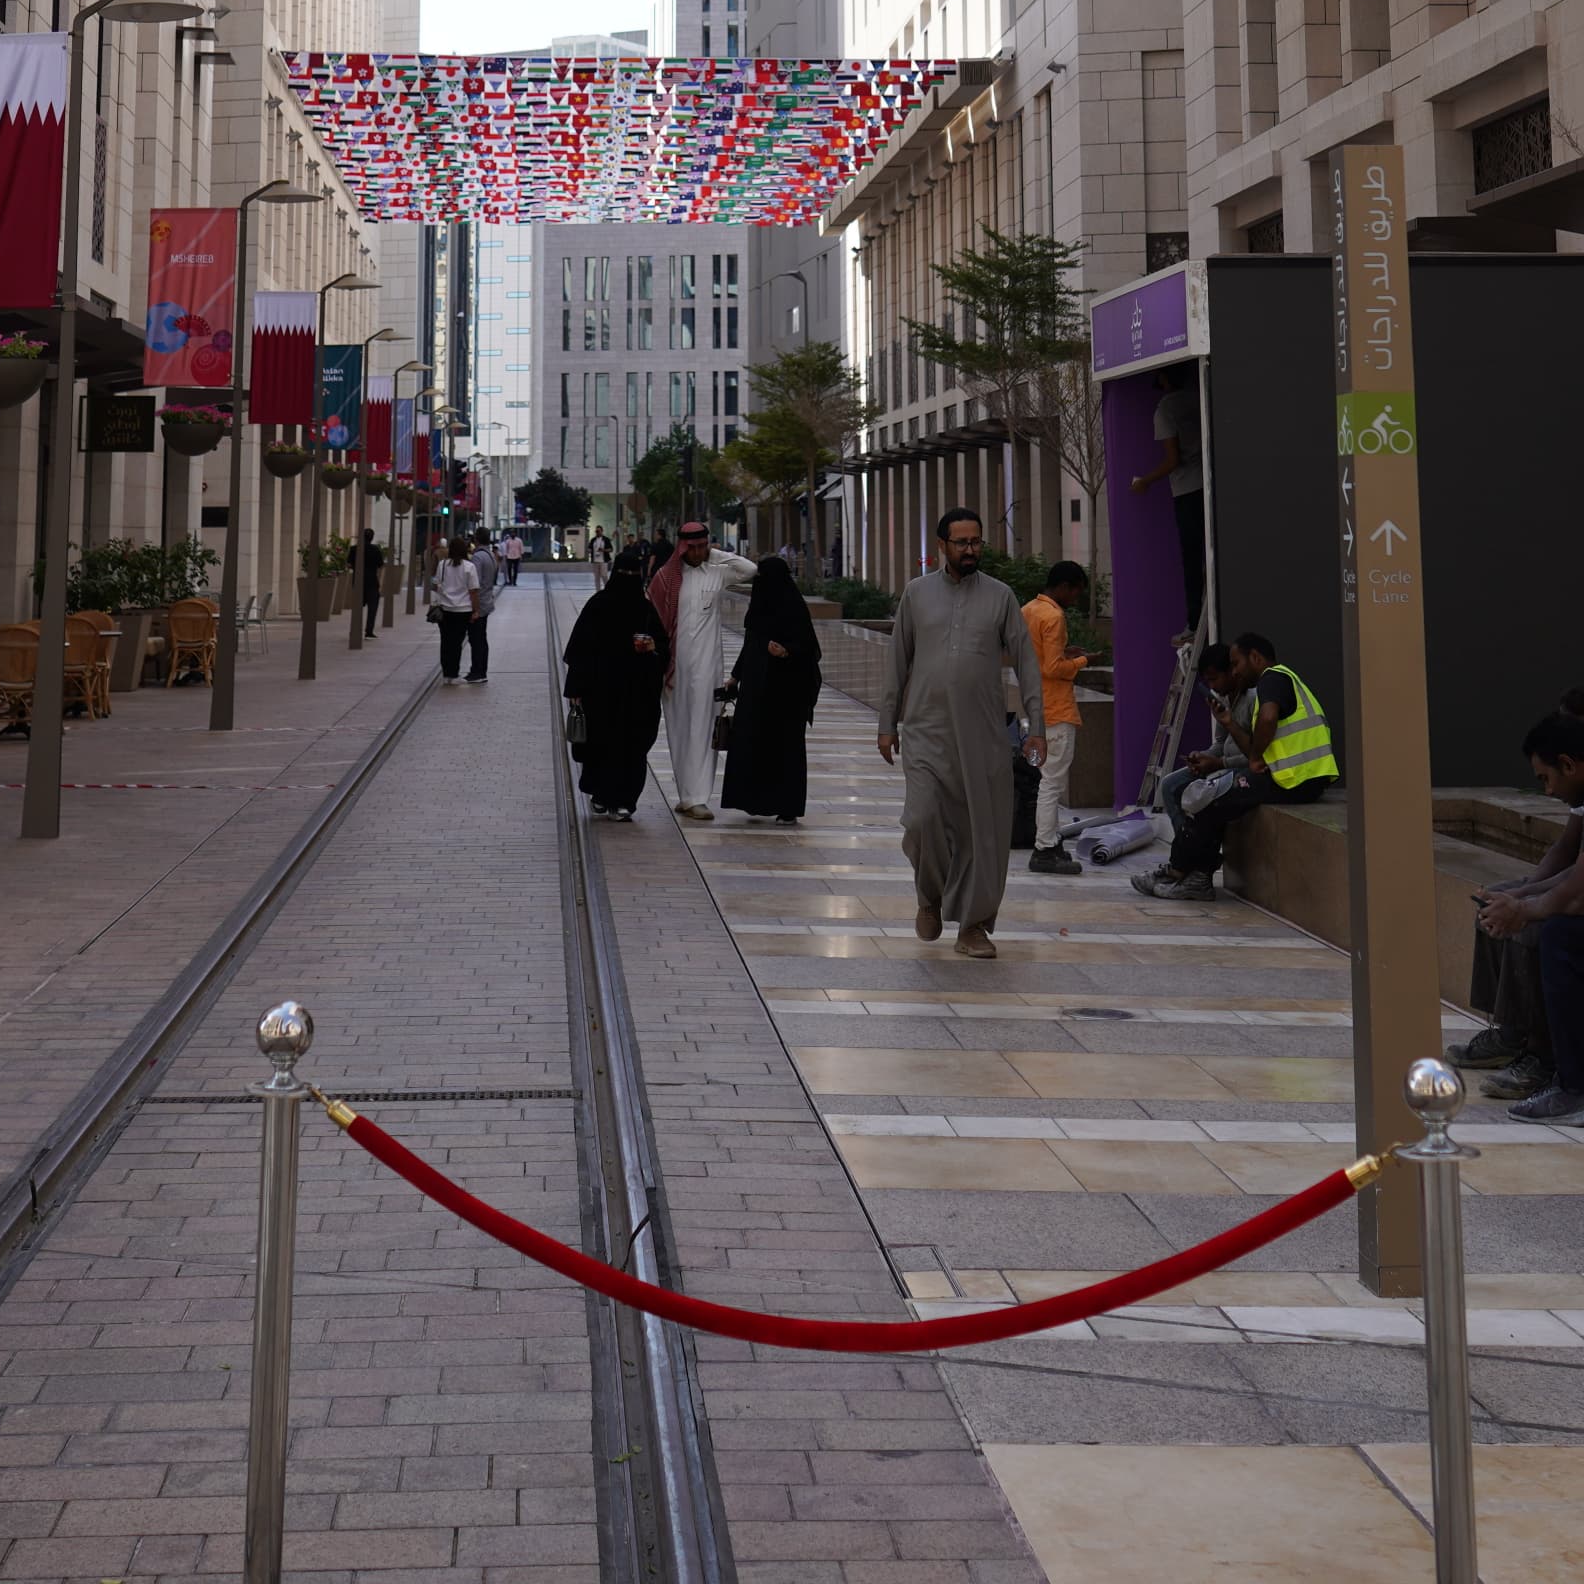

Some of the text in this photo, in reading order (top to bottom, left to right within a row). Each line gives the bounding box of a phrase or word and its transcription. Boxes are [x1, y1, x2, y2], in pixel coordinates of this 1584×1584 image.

[1361, 166, 1399, 370] طريق للدراجات
[1368, 569, 1412, 589] Cycle
[1372, 587, 1408, 603] Lane
